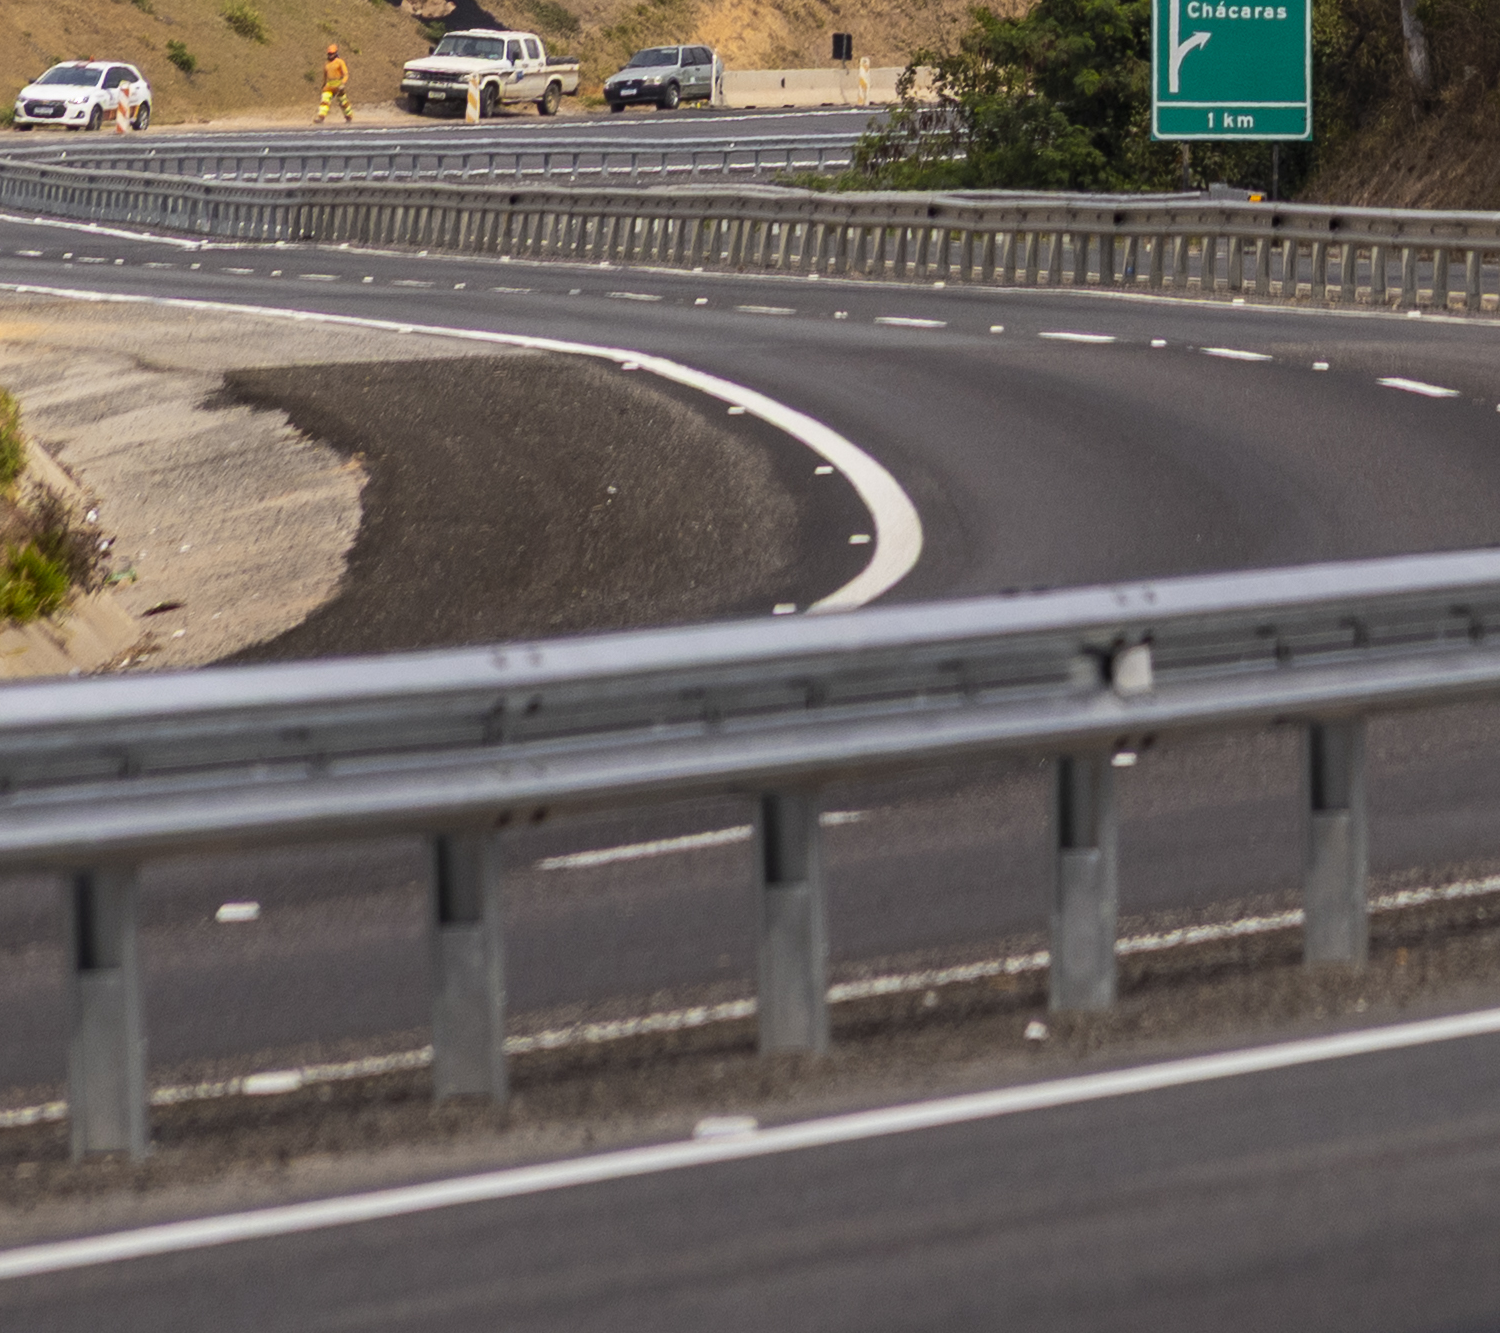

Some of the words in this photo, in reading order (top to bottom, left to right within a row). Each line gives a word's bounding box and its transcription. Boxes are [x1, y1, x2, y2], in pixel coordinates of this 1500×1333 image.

[1187, 1, 1287, 19] Chácaras
[1207, 112, 1213, 128] 1
[1224, 112, 1254, 128] km
